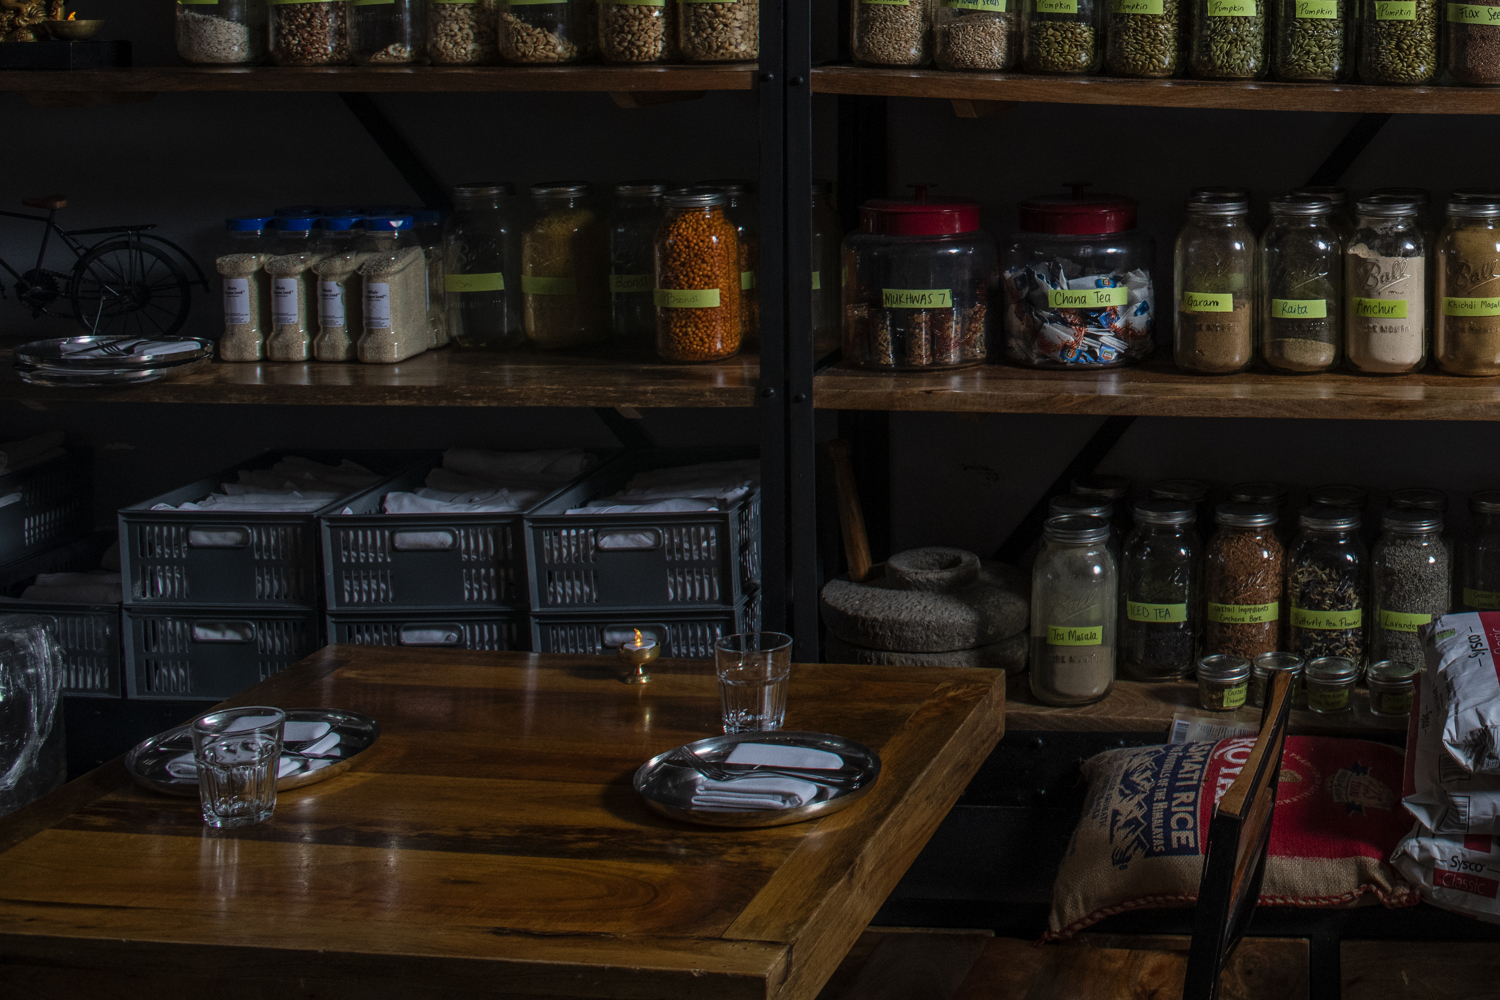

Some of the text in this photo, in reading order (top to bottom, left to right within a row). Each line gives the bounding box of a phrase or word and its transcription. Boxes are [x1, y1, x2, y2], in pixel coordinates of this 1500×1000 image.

[1213, 1, 1244, 13] Pumpkin
[1299, 3, 1333, 15] Pumpkin
[1380, 3, 1411, 16] Pumpkin
[1459, 7, 1479, 19] Flax
[616, 277, 648, 288] Boondi
[665, 293, 698, 304] Boondi
[885, 292, 946, 305] MUKHWAS 7
[1055, 291, 1111, 305] Chana Tea
[1188, 296, 1219, 306] Garam
[1282, 302, 1308, 315] Raita
[1356, 299, 1397, 314] Amchur
[1448, 300, 1476, 310] Khichdi
[1130, 604, 1170, 620] ICED TEA
[1294, 611, 1321, 626] Butterfly
[1339, 618, 1360, 626] Flower
[1052, 629, 1098, 641] Tea Masala
[1468, 634, 1488, 659] Sysco
[1152, 788, 1169, 852] THE HIMALAYAS
[1170, 791, 1196, 849] RICE
[1450, 855, 1485, 873] Sysco
[1442, 872, 1486, 894] Classic
